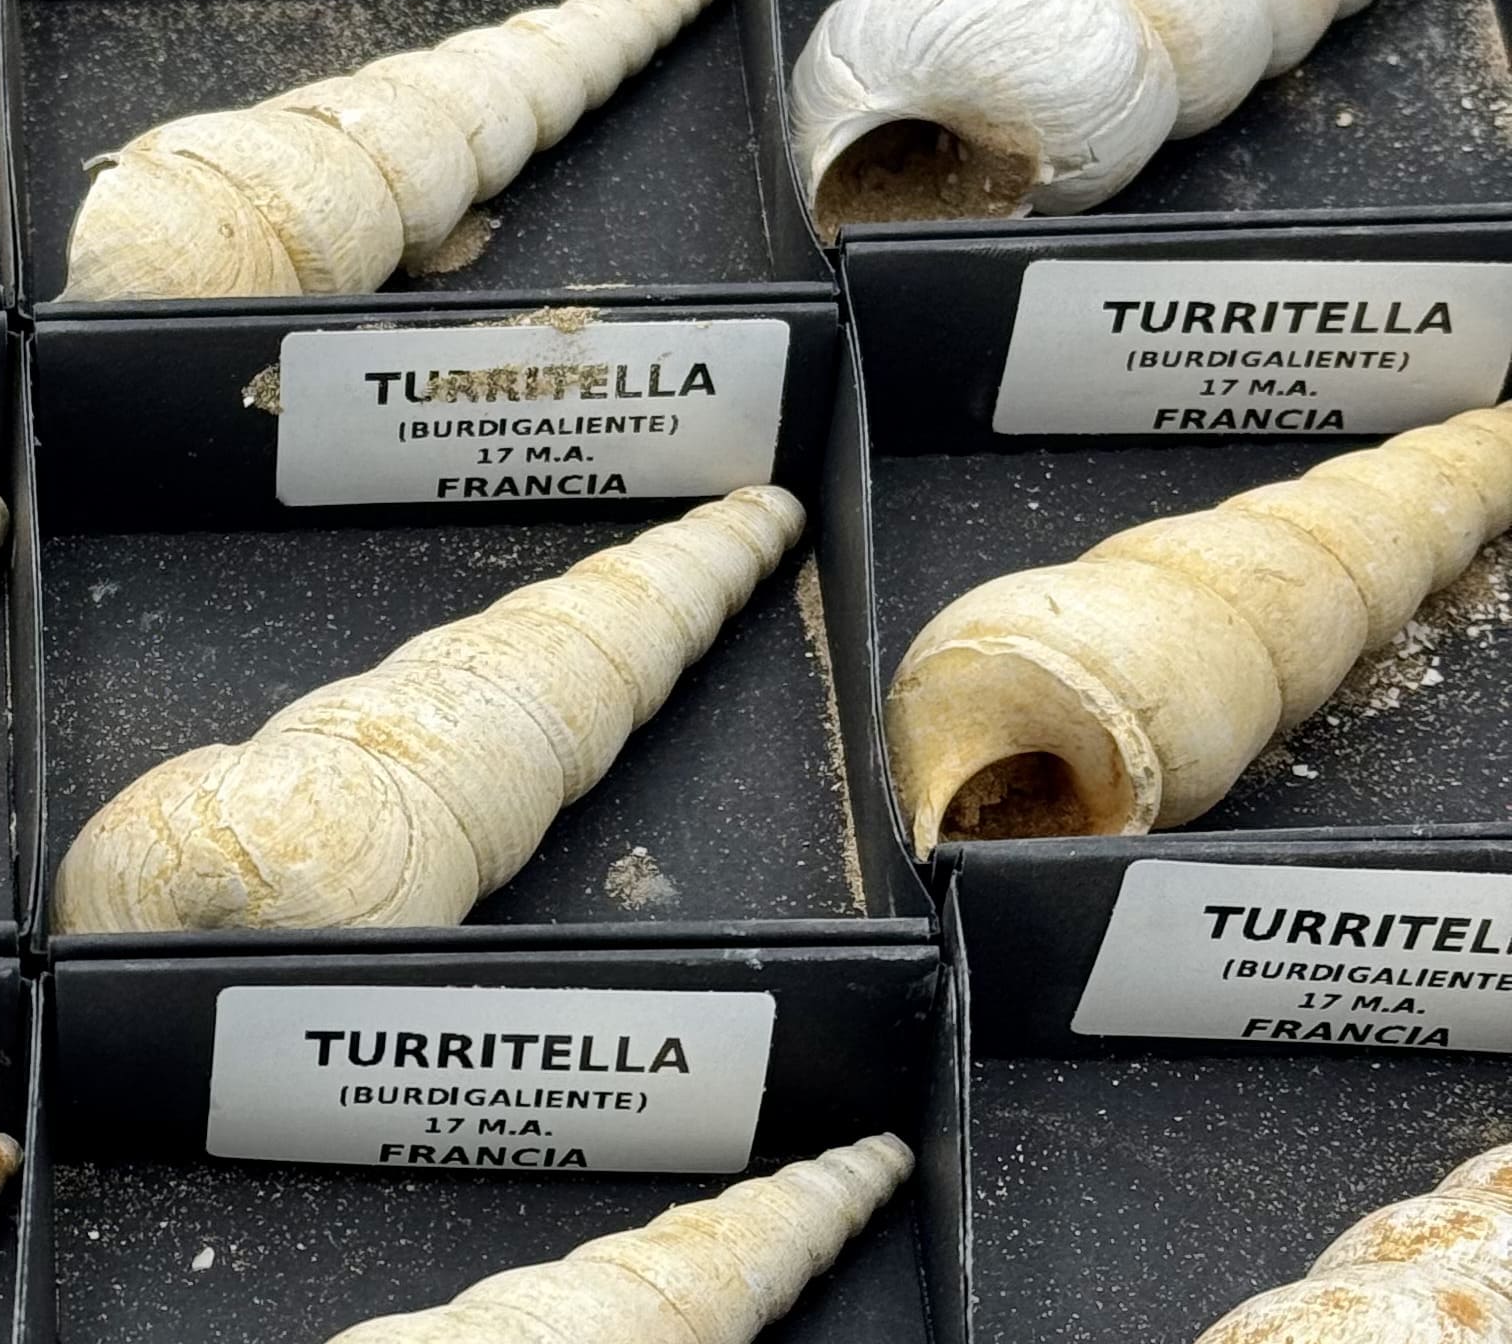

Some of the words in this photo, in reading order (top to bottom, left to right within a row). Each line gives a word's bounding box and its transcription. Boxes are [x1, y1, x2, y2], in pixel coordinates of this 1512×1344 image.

[1104, 300, 1453, 336] TURRITELLA
[1126, 349, 1410, 373] (BURDIGALIENTE)
[1199, 379, 1237, 397] 17
[1249, 379, 1318, 398] M.A.
[398, 414, 678, 442] (BURDIGALIENTE)
[1153, 408, 1345, 433] FRANCIA
[477, 448, 513, 466] 17
[524, 446, 594, 464] M.A.
[437, 472, 627, 500] FRANCIA
[1204, 906, 1512, 955] TURRITEL
[1298, 992, 1338, 1010] 17
[1351, 996, 1426, 1016] M.A.
[1241, 1018, 1451, 1047] FRANCIA
[306, 1030, 690, 1074] TURRITELLA
[339, 1085, 649, 1114] (BURDIGALIENTE)
[424, 1118, 464, 1136] 17
[478, 1118, 553, 1138] M.A.
[379, 1143, 589, 1170] FRANCIA
